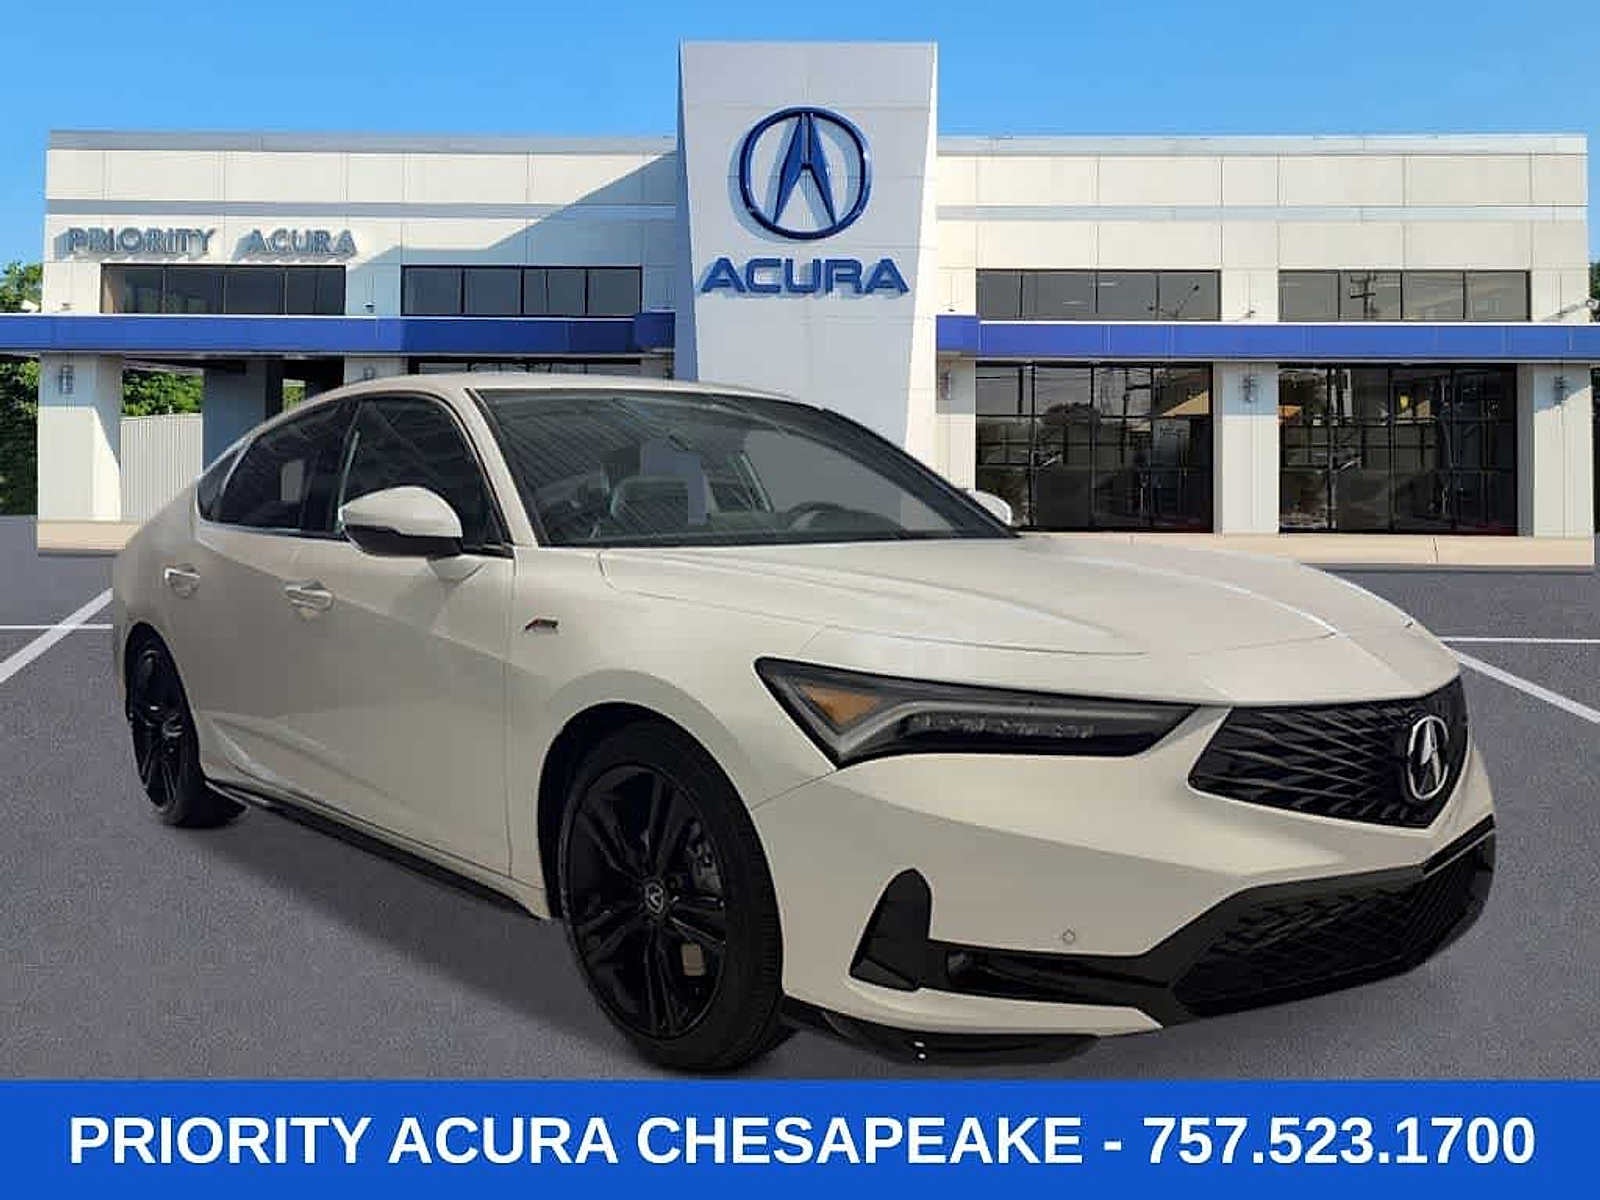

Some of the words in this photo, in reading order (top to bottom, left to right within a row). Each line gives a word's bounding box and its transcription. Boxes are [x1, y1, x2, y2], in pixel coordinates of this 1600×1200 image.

[67, 226, 215, 252] PRIORITY
[248, 228, 356, 256] ACURA
[700, 256, 909, 295] ACURA
